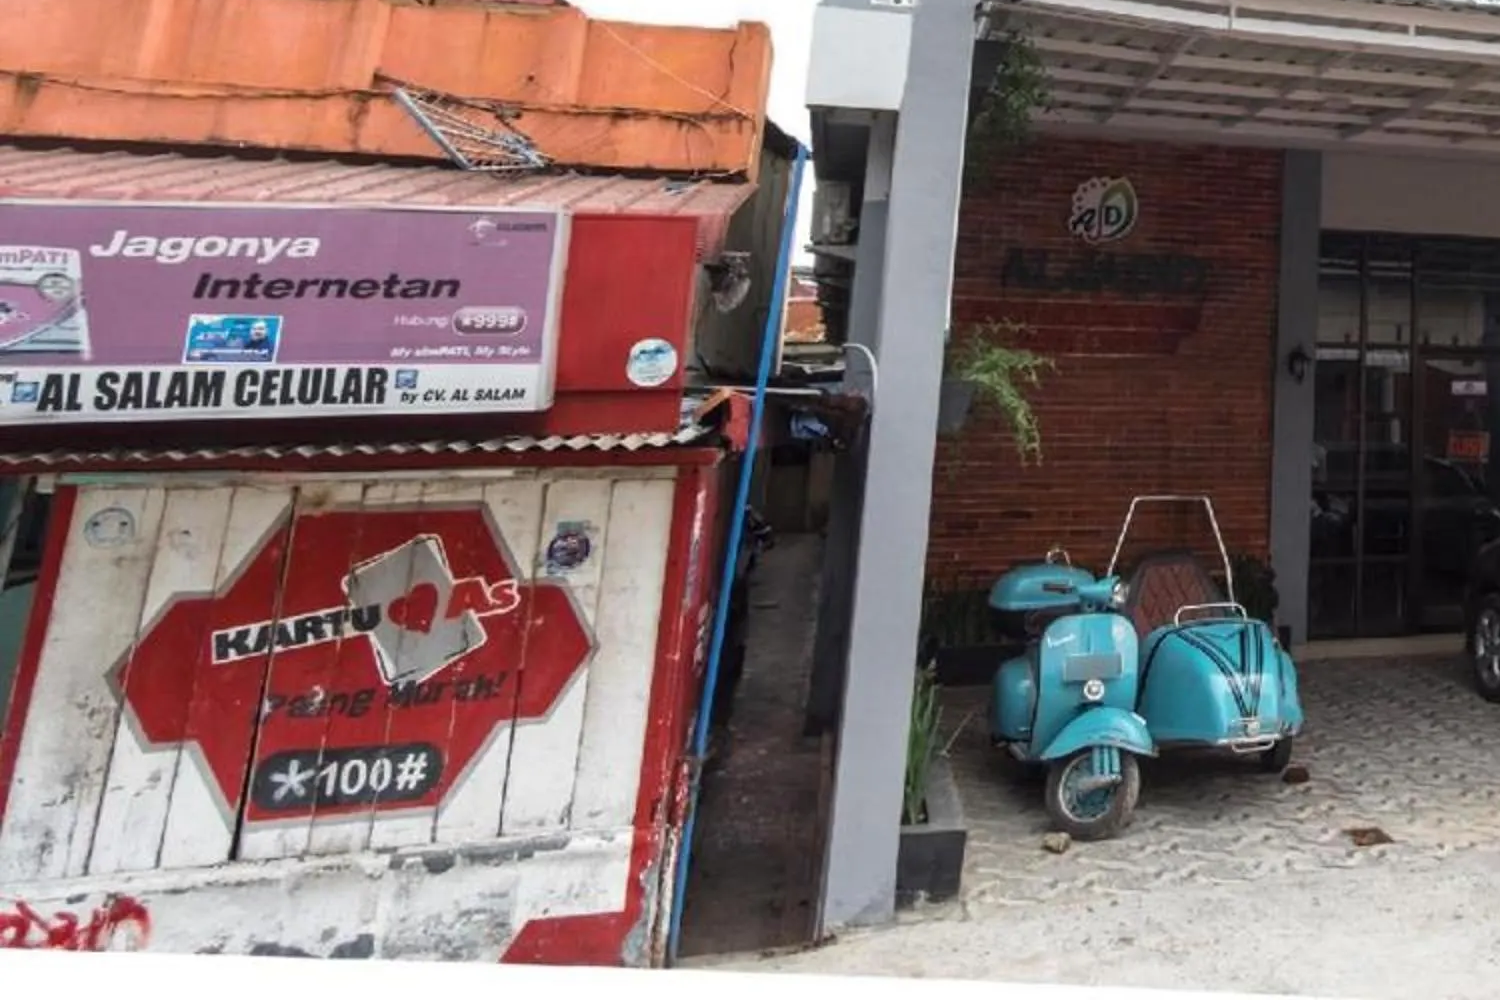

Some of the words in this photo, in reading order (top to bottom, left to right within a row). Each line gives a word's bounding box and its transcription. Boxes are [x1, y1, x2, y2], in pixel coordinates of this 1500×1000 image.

[89, 230, 321, 264] Jagonya
[192, 273, 462, 300] Internetan
[36, 373, 83, 412] AL
[93, 370, 227, 411] SALAM
[232, 367, 389, 406] CELULAR
[400, 391, 419, 404] by
[450, 388, 470, 401] AL
[474, 388, 526, 401] SALAM
[214, 603, 382, 661] KARTU
